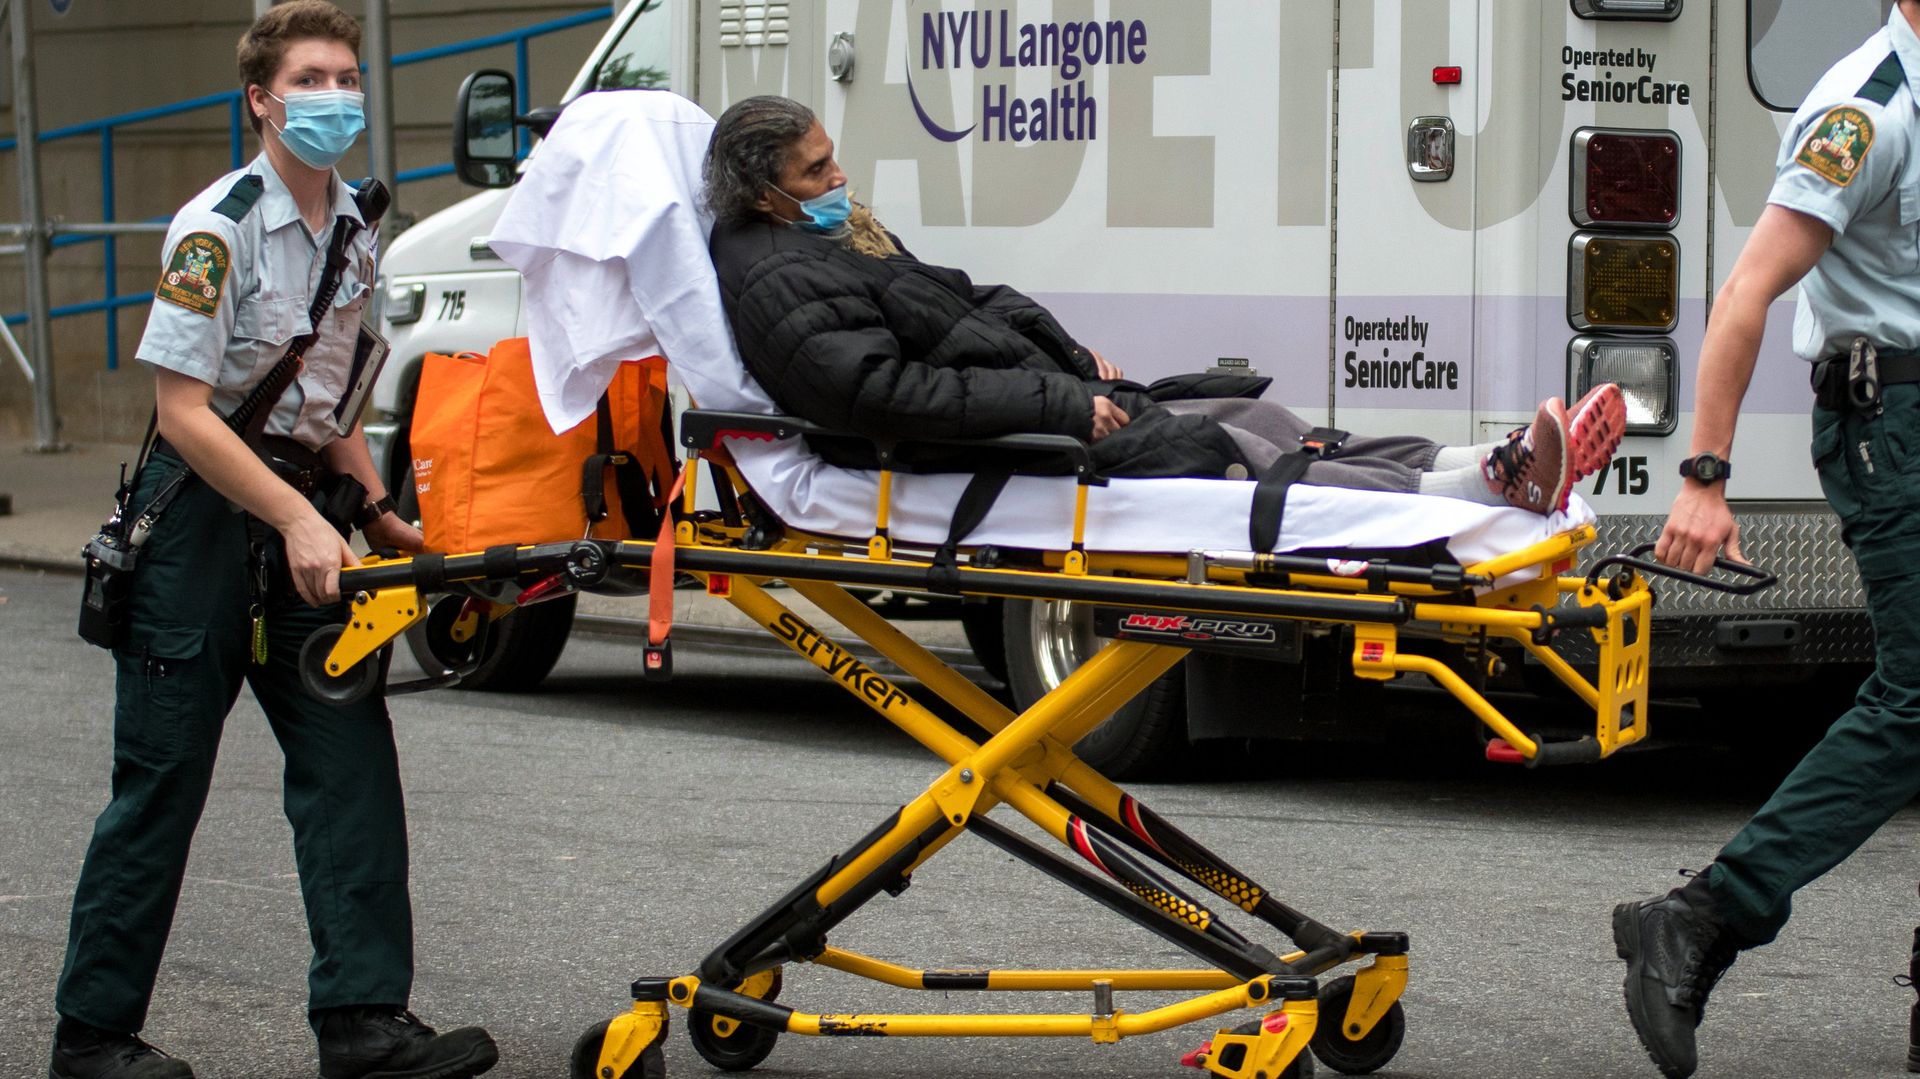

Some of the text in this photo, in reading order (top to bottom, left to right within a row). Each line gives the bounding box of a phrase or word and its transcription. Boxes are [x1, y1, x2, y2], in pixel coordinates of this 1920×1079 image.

[922, 9, 1147, 80] NYU Langone
[1561, 45, 1657, 73] Operated by
[1561, 71, 1690, 105] SeniorCare
[983, 80, 1097, 142] Health
[437, 290, 467, 321] 715
[1344, 315, 1429, 347] Operated by
[1344, 347, 1458, 390] SeniorCare
[1592, 456, 1650, 496] 715
[1125, 613, 1271, 636] MX-PRO
[769, 612, 909, 710] stryker
